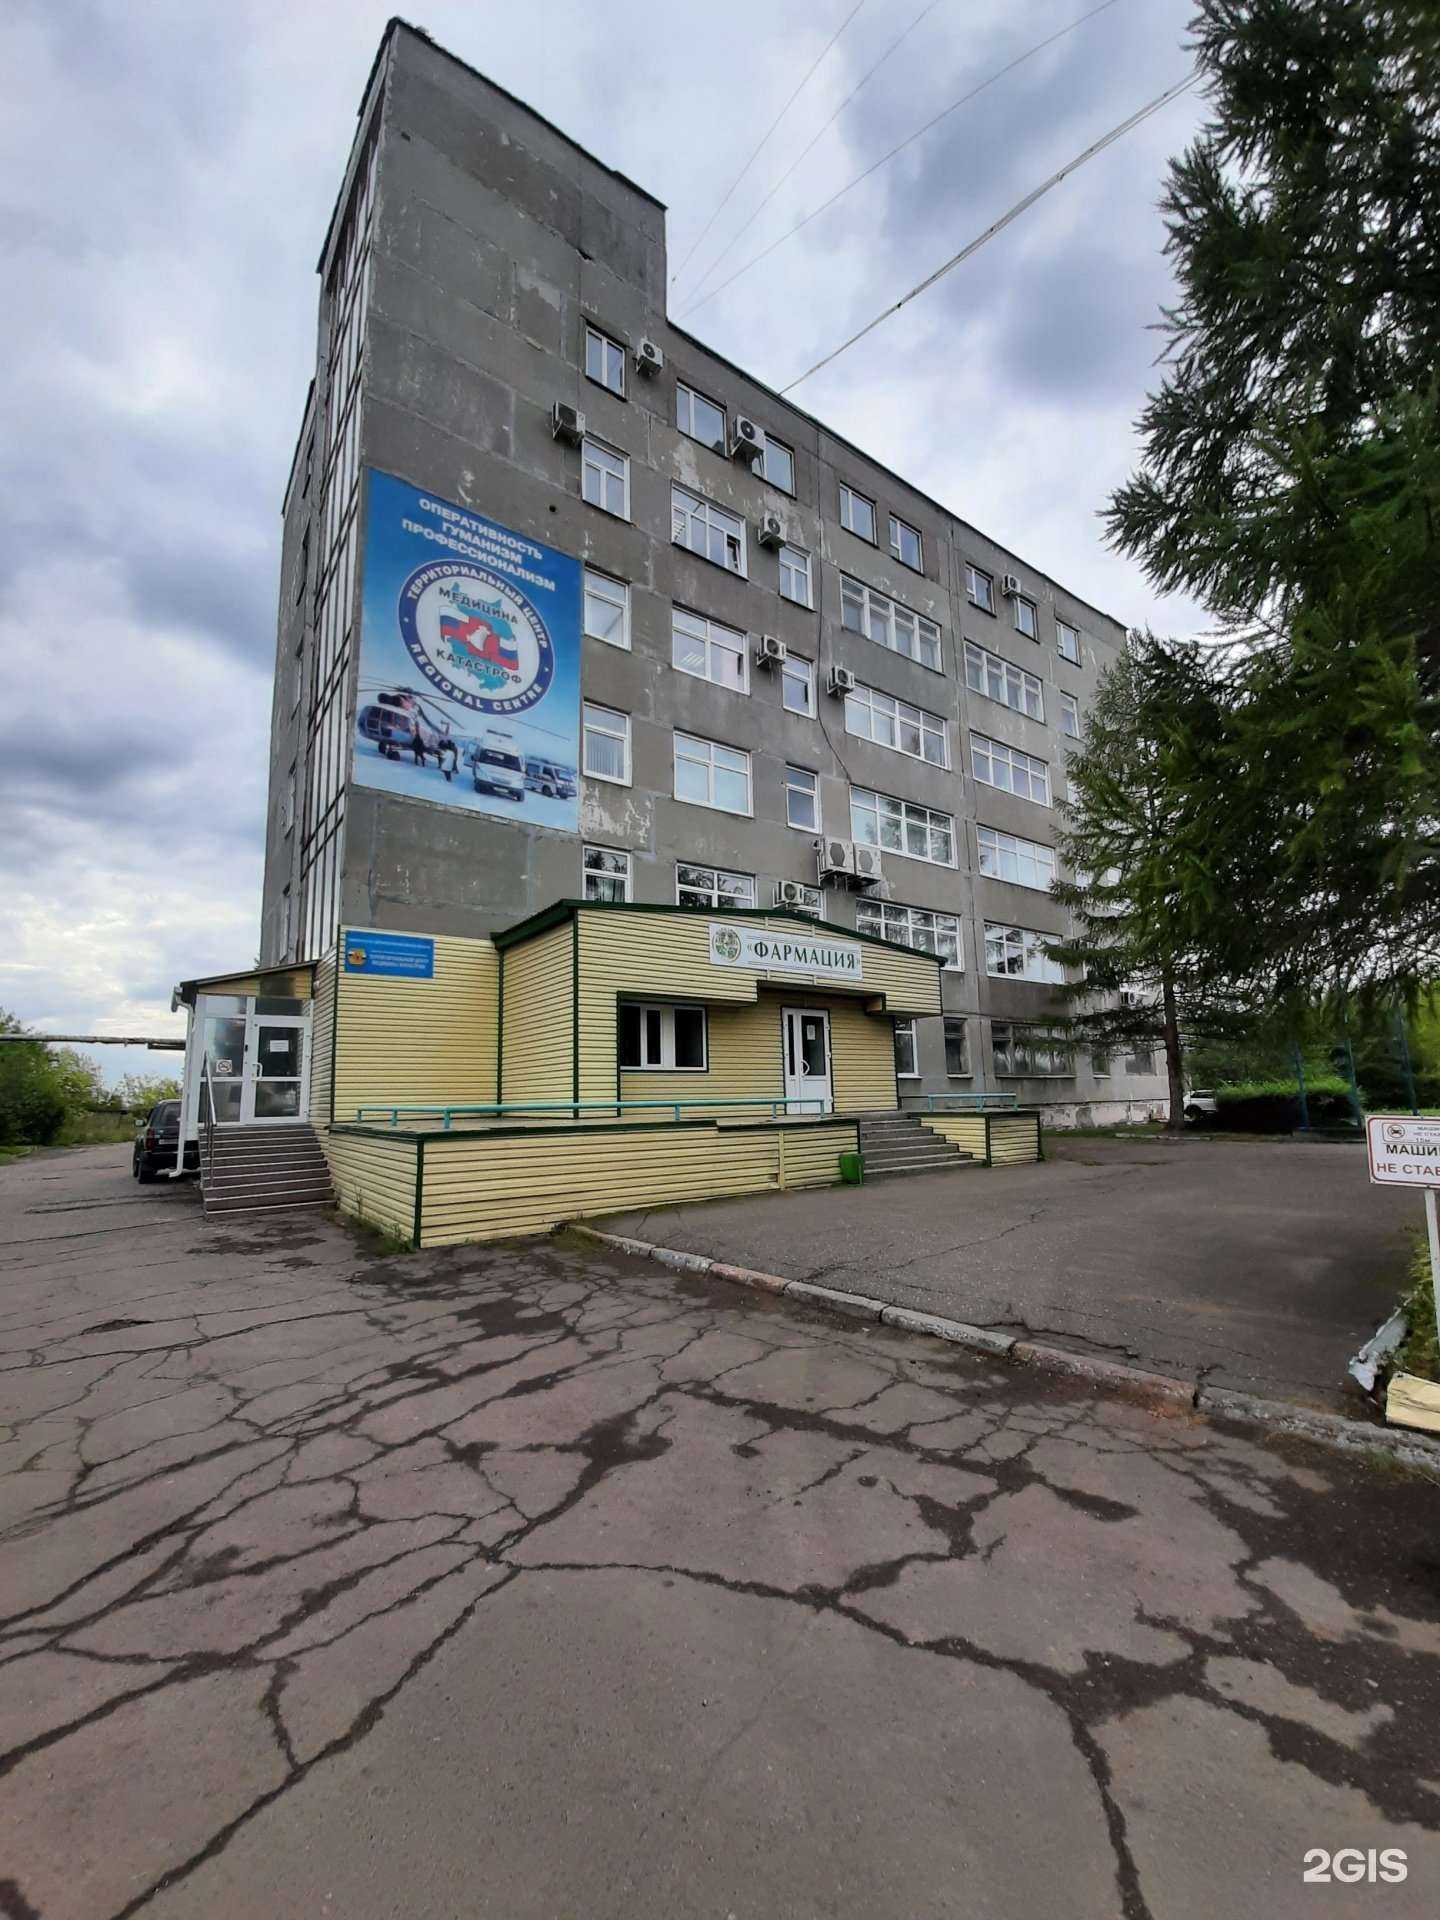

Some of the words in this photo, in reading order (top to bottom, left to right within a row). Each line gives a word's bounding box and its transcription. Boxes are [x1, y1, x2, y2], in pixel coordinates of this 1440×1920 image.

[418, 498, 543, 560] ОПЕРАТИВНОСТЬ
[442, 521, 522, 564] ГУМАНИЗМ
[401, 518, 556, 592] ПРОФЕССИОНАЛИЗМ
[406, 565, 525, 606] ТЕРРИТОРИАЛЬНЫЙ
[522, 605, 549, 649] ЦЕНТР
[438, 587, 519, 624] МЕДИЦИНА
[409, 643, 484, 709] REGIONAL
[491, 682, 543, 711] CENTRE
[436, 648, 523, 685] КАТАСТРОФ
[1377, 1163, 1397, 1173] НЕ
[1386, 1144, 1440, 1156] МАШИ
